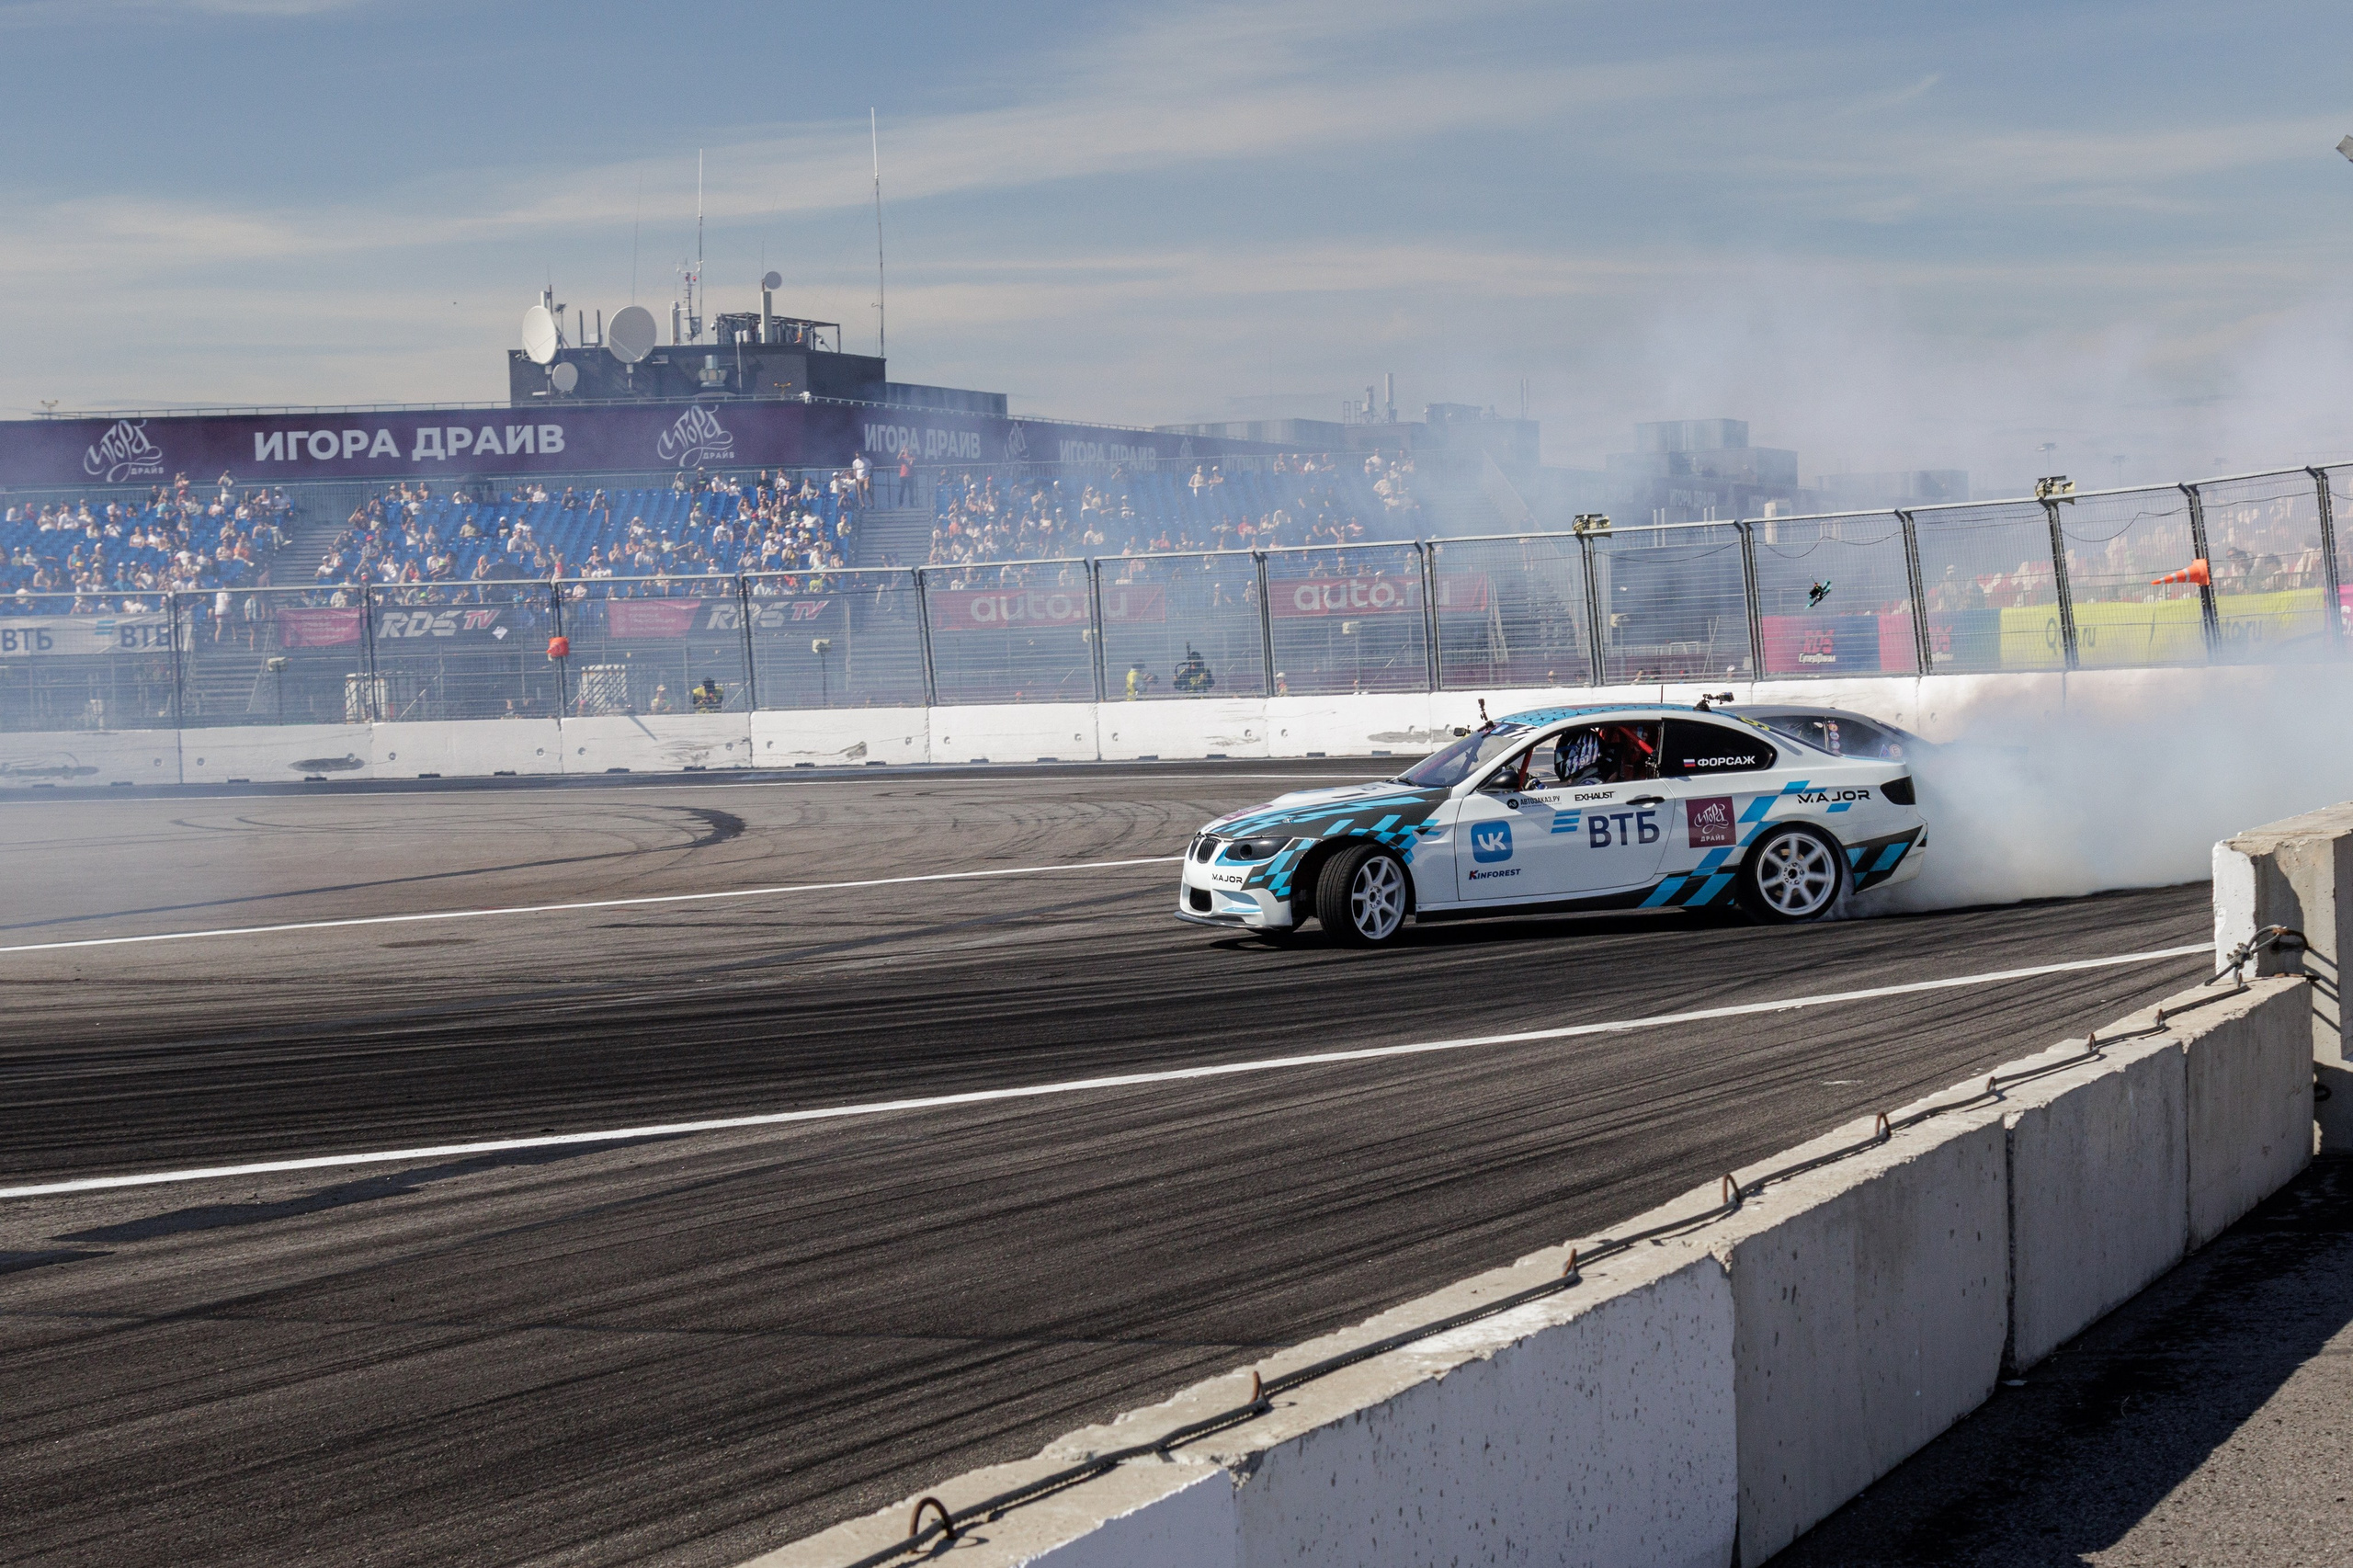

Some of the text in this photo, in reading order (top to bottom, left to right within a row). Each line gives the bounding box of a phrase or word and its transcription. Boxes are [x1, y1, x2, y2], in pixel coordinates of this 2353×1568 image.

[255, 424, 565, 461] ИГОРА ДРАЙВ
[864, 423, 919, 455] ИГОРА
[1059, 439, 1106, 468] ИГОРА
[790, 599, 831, 621] TV
[378, 608, 503, 639] RDS TV
[2, 627, 53, 652] ВТБ
[1697, 755, 1756, 767] ФОРСАЖ
[1574, 790, 1615, 801] EXHAUST
[1797, 789, 1871, 804] MAJOR
[1587, 810, 1660, 848] ВТБ
[1700, 834, 1725, 842] ДРАЙВ
[1477, 831, 1506, 852] VK
[1211, 873, 1243, 884] MAJOR
